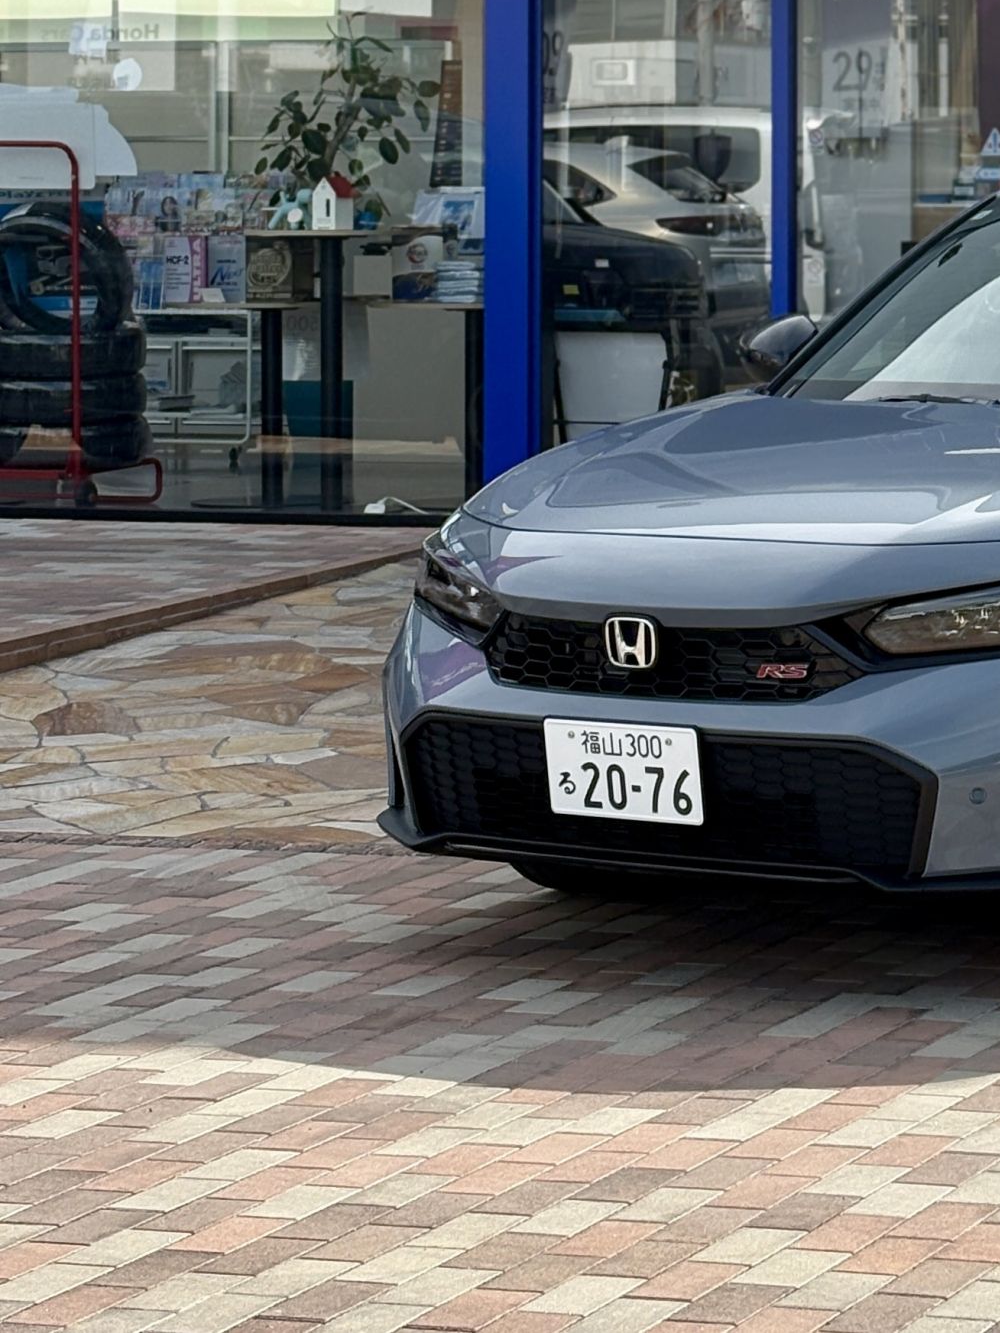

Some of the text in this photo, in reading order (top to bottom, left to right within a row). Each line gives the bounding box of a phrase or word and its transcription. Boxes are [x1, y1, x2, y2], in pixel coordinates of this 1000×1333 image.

[756, 664, 808, 678] RS
[558, 761, 693, 816] る 20-76
